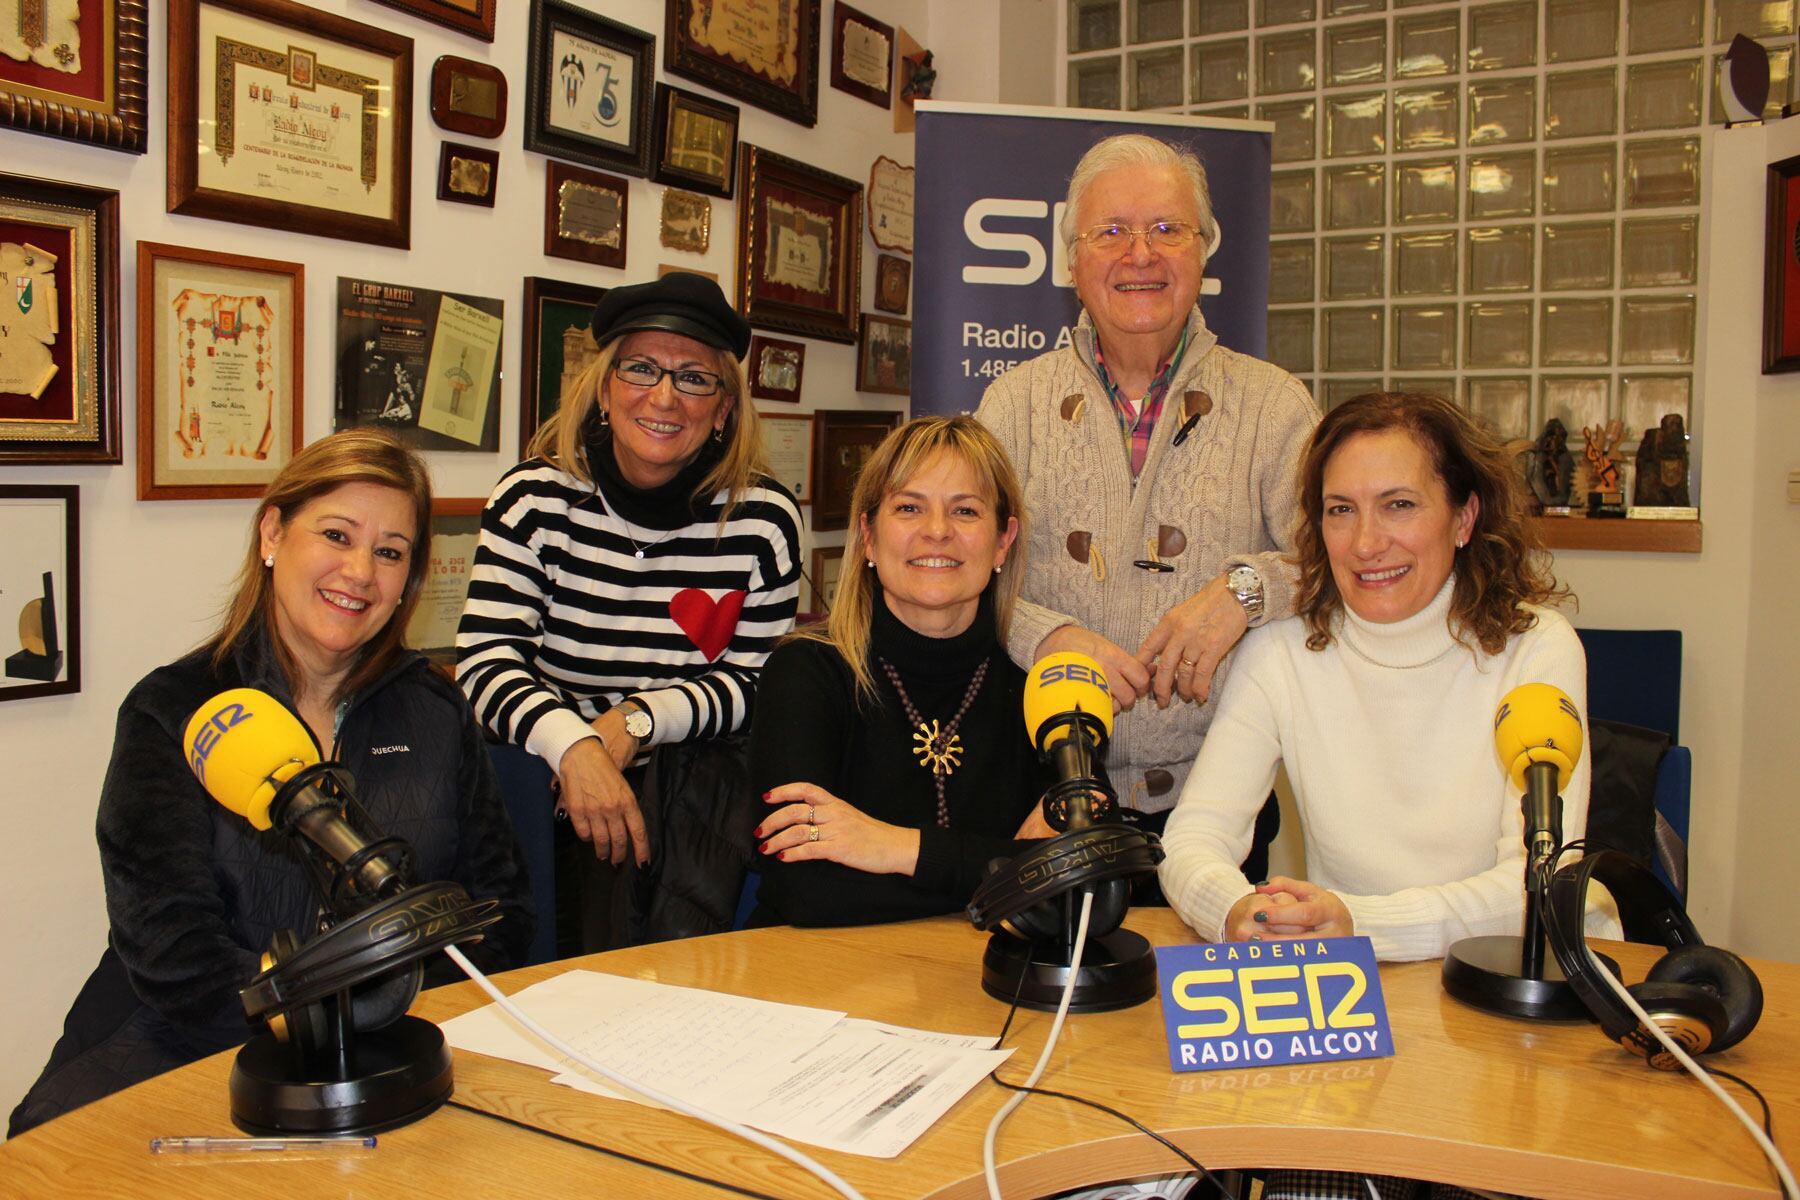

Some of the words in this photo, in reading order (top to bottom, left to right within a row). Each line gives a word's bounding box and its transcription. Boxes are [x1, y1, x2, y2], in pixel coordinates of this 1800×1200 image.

[353, 282, 360, 294] EL
[363, 284, 381, 297] GRUP
[962, 321, 1046, 350] Radio
[1039, 663, 1111, 697] SER
[191, 703, 254, 787] SER
[371, 745, 410, 756] QUECHUA
[1205, 942, 1328, 962] CADENA
[1172, 961, 1376, 1040] SER
[1180, 1038, 1274, 1065] RADIO
[1290, 1030, 1378, 1057] ALCOY
